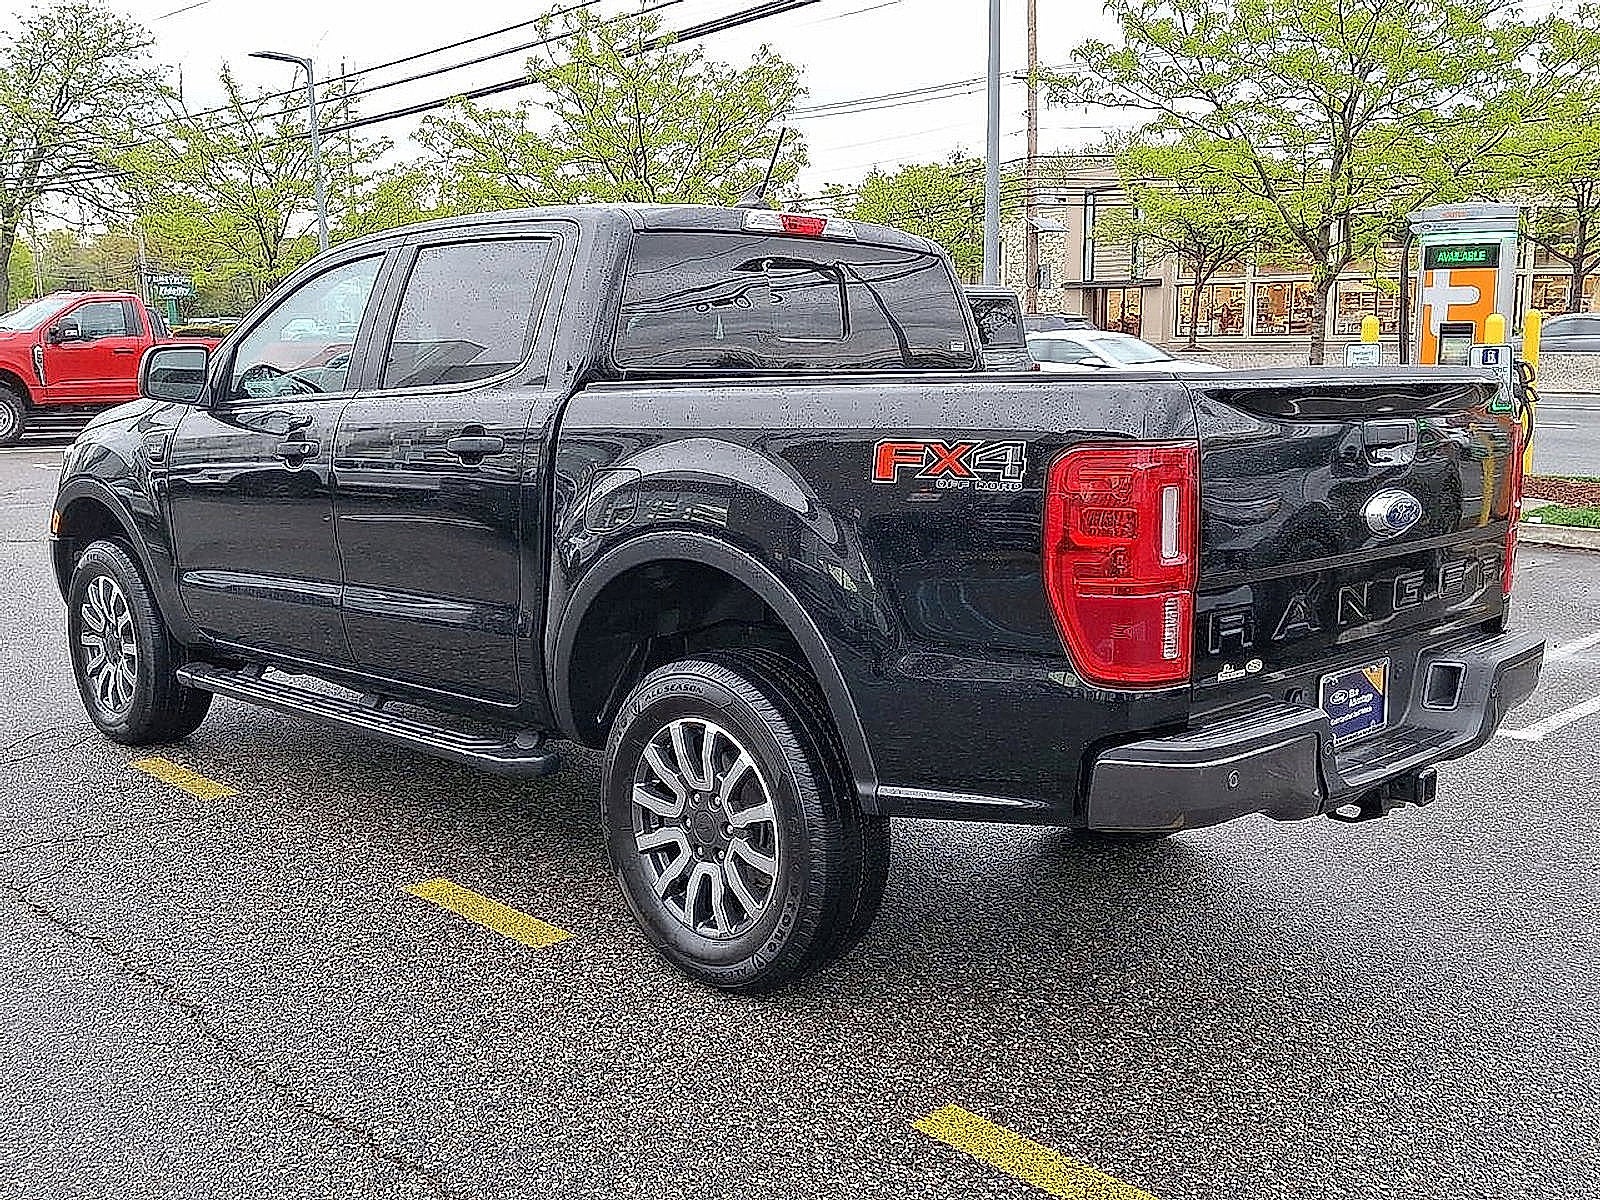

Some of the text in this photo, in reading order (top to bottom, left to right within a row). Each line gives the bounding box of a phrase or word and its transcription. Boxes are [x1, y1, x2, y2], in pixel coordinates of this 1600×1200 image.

[1437, 250, 1486, 263] AVAILABLE
[872, 439, 1026, 484] FX4
[936, 479, 970, 489] OFF
[1207, 556, 1498, 654] RANGER
